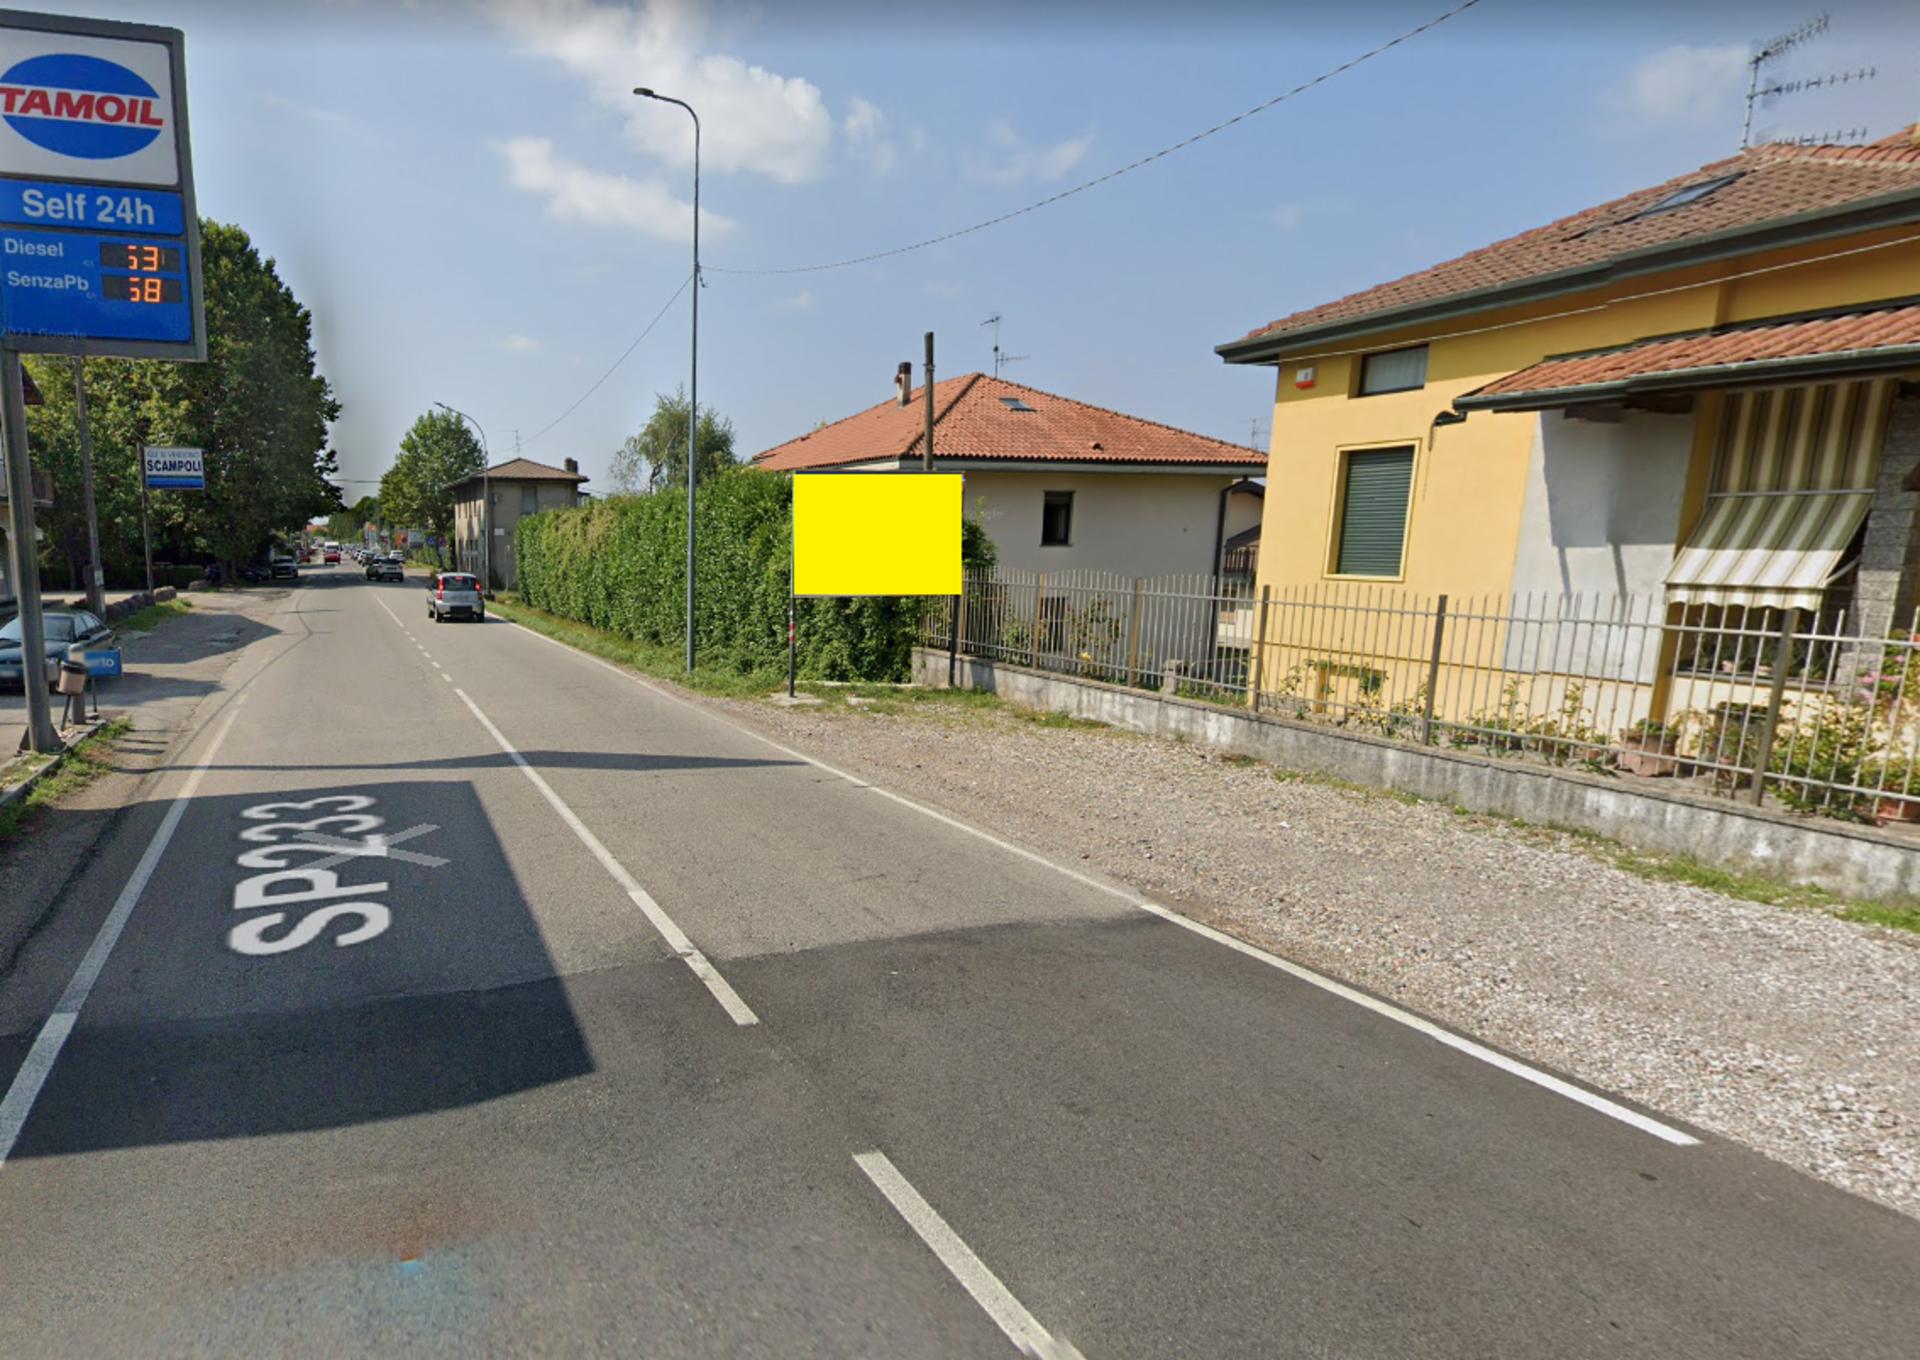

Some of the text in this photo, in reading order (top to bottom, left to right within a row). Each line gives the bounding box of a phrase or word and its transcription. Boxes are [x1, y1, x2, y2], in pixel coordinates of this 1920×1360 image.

[0, 87, 163, 126] TAMOIL
[22, 189, 155, 225] Self 24h
[4, 238, 64, 257] Diesel
[7, 270, 90, 291] SenzaPb
[147, 459, 201, 471] SCAMPOLI
